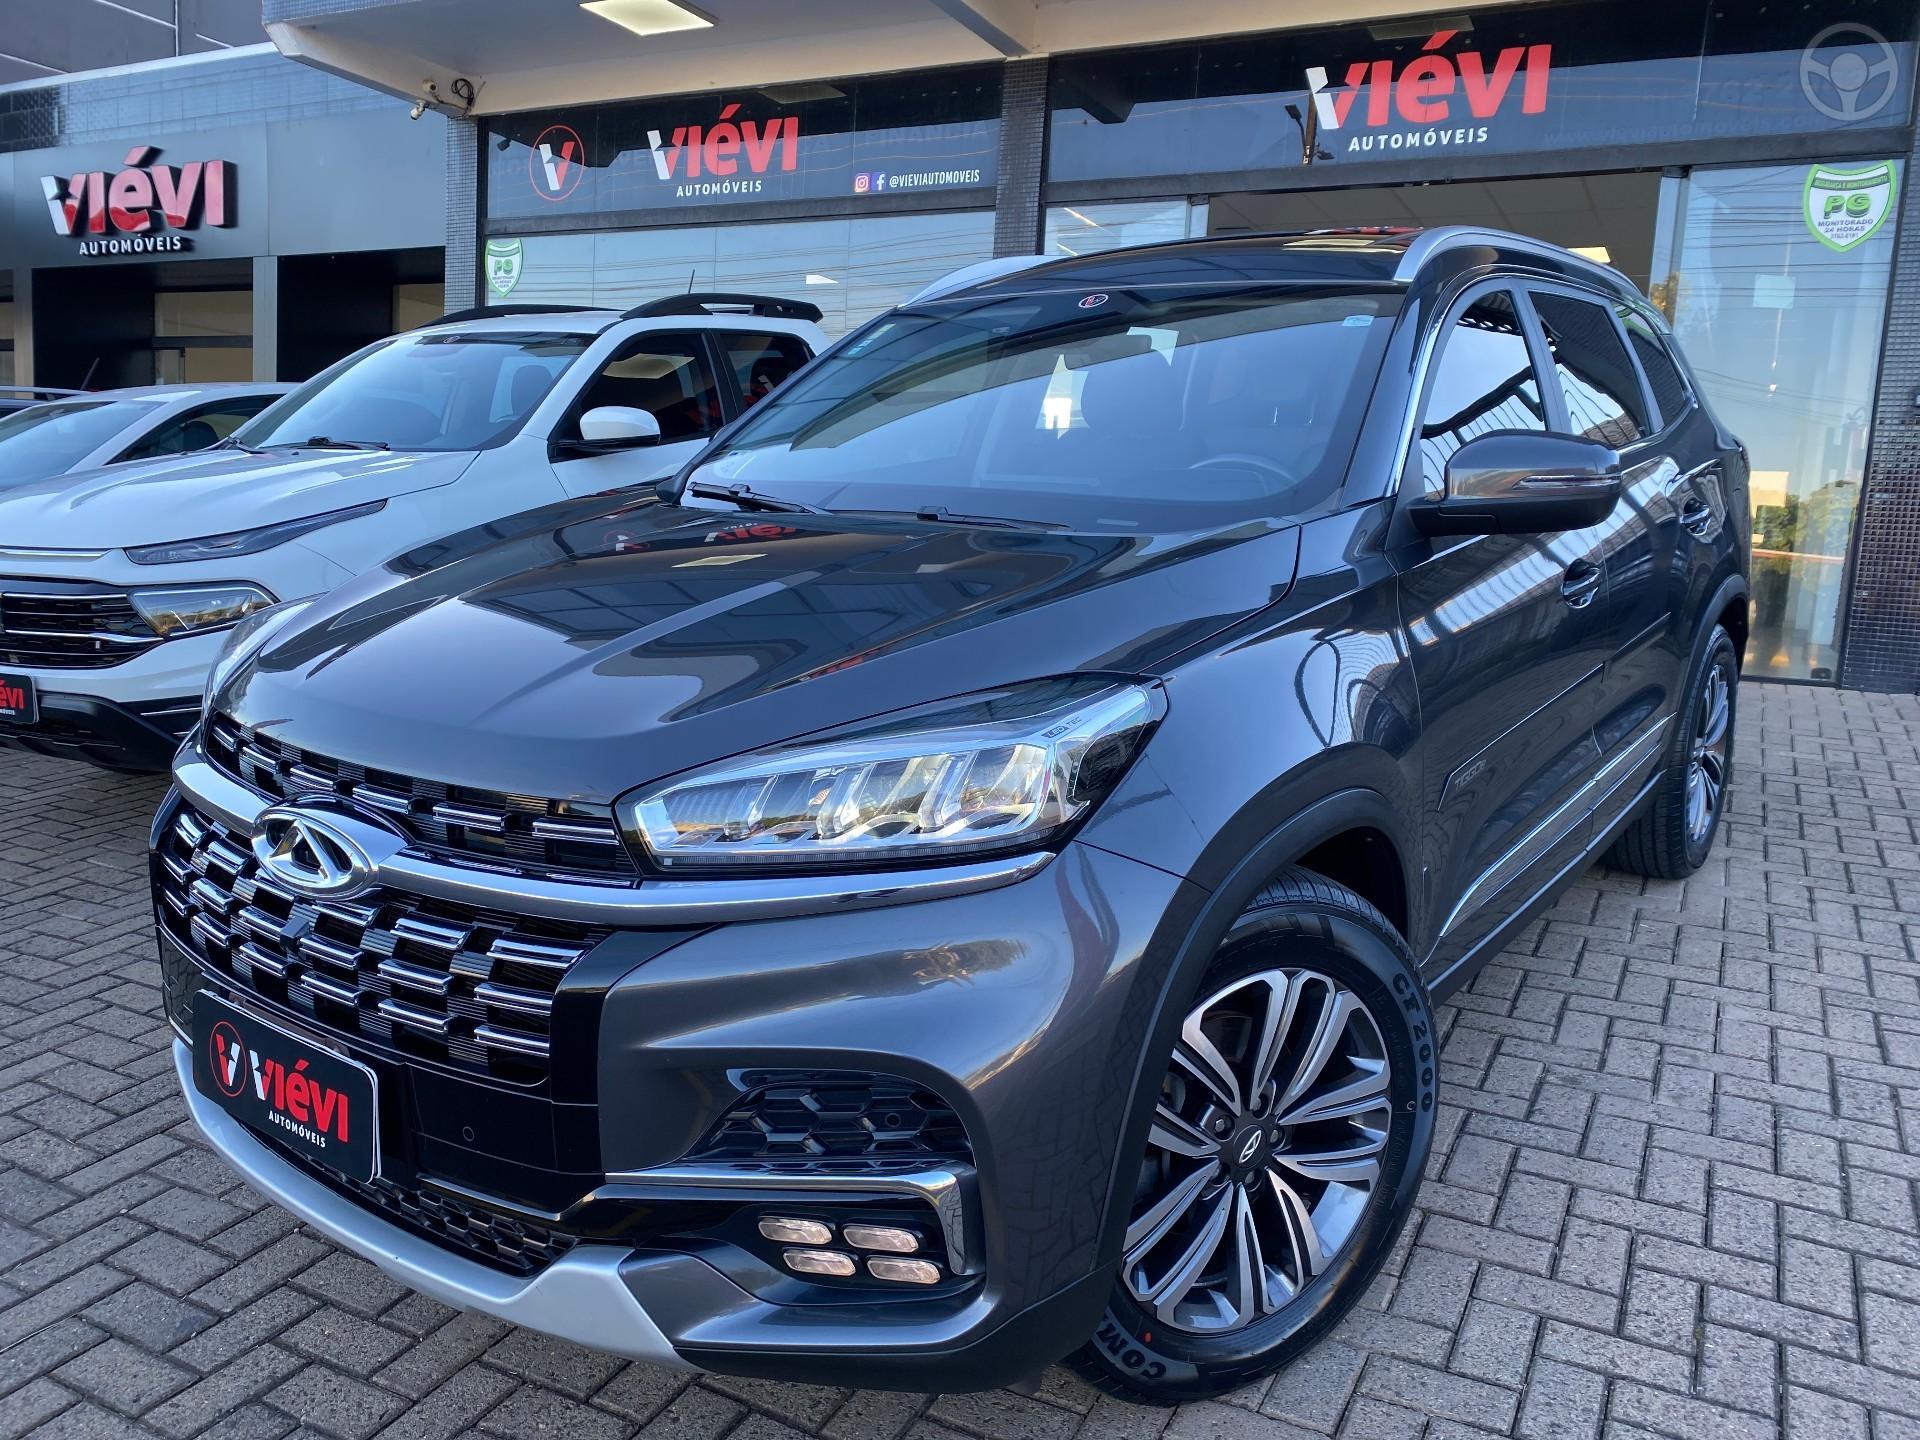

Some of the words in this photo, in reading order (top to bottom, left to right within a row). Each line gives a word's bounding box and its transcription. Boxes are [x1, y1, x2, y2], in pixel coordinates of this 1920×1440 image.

[1348, 127, 1489, 152] AUTOMÓVEIS
[676, 180, 762, 197] AUTOMÓVEIS
[889, 170, 980, 188] @VIEVIAUTOMOVEIS
[1823, 193, 1870, 219] PG
[1818, 219, 1874, 227] MONITORADO
[79, 233, 182, 255] AUTOMÓVEIS
[1048, 726, 1065, 737] LED
[269, 1110, 326, 1148] AUTOMÓVEIS
[1096, 1311, 1167, 1379] COM
